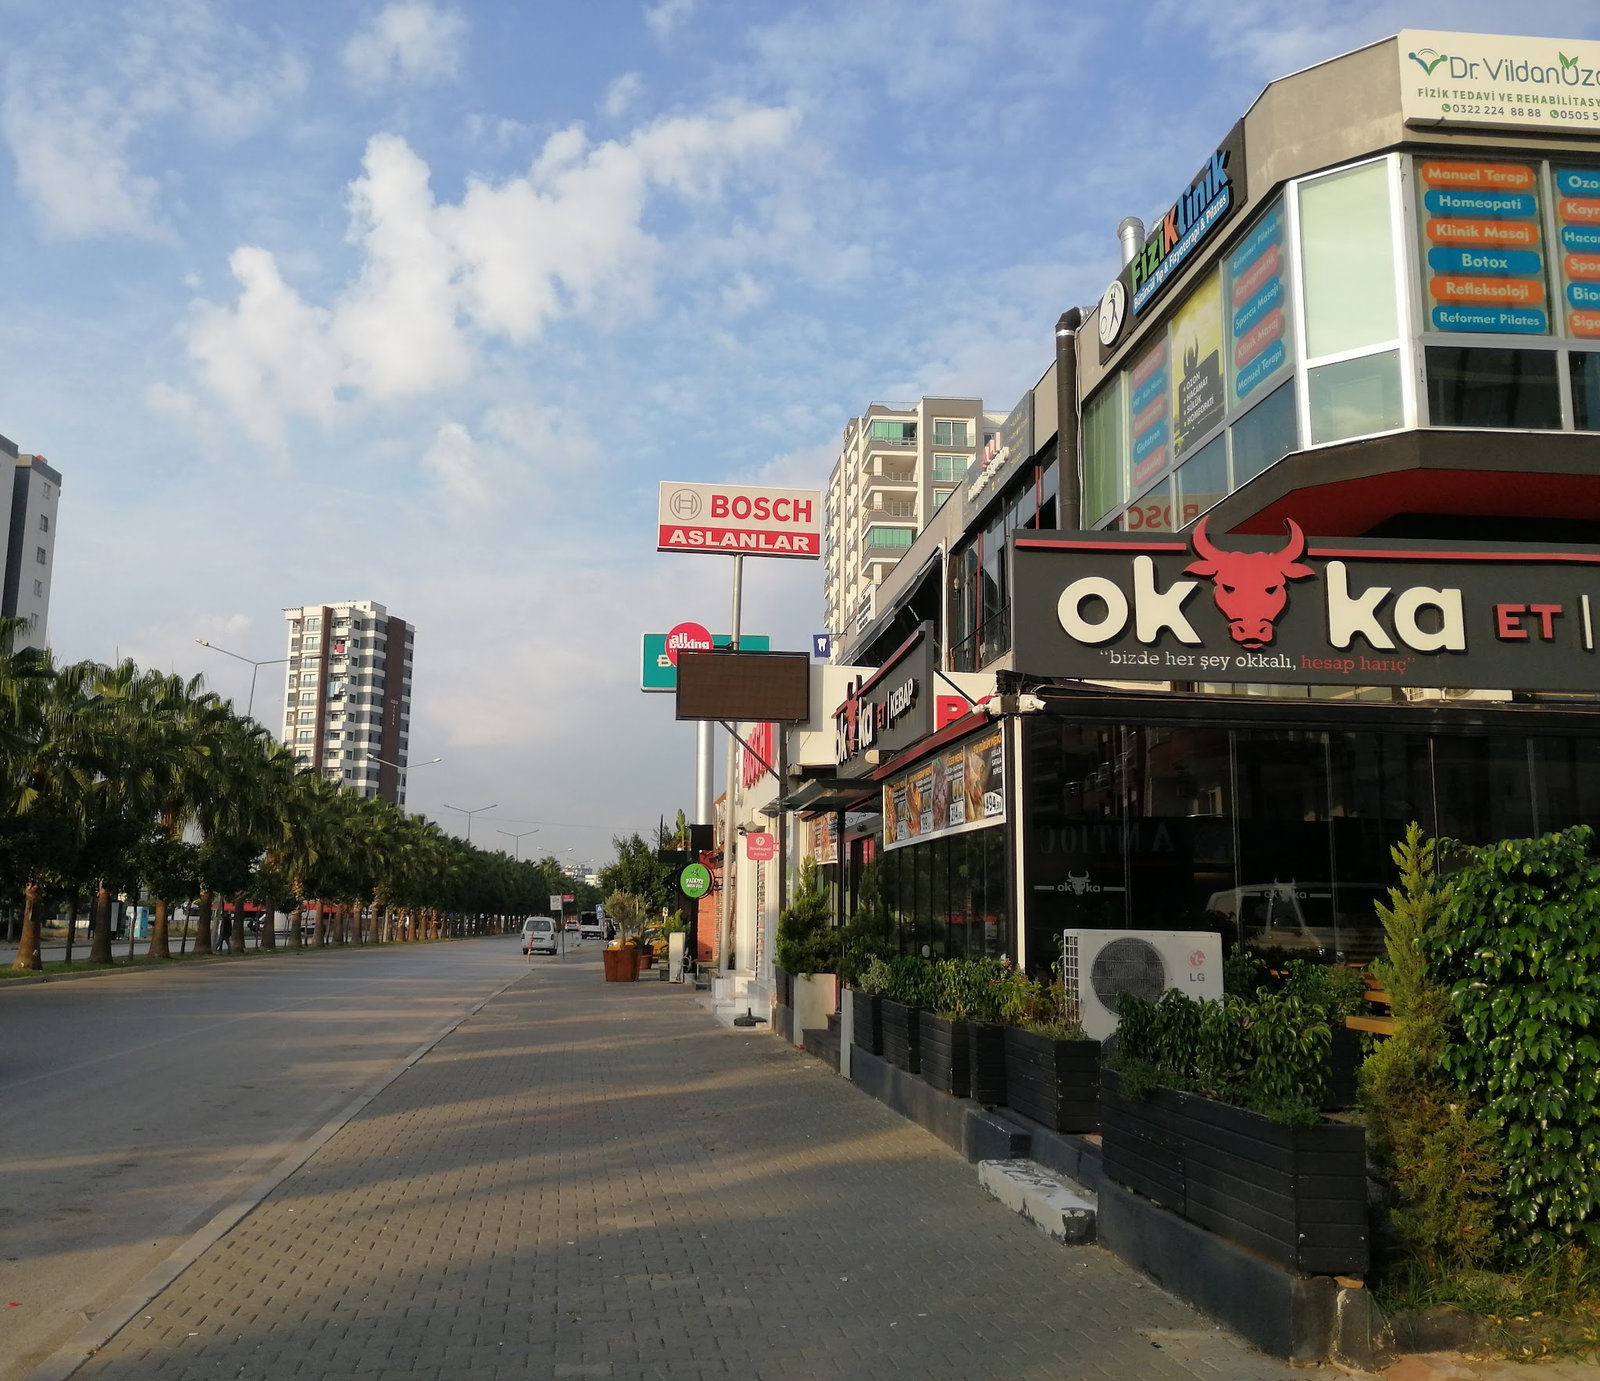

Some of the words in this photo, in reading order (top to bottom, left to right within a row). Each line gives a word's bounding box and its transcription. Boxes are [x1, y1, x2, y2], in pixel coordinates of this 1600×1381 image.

[1449, 56, 1479, 80] Dr.
[1483, 57, 1560, 84] Vildan
[1418, 87, 1449, 99] FİZİK
[1453, 89, 1495, 101] TEDAVİ
[1499, 93, 1513, 103] VE
[1453, 104, 1481, 114] 0322
[1484, 105, 1505, 115] 224
[1510, 107, 1526, 117] 88
[1528, 108, 1541, 118] 88
[1560, 110, 1590, 120] 0505
[1428, 168, 1481, 181] Manuel
[1484, 169, 1529, 185] Terapi
[1439, 194, 1522, 211] Homeopati
[1436, 223, 1479, 238] Klinik
[1484, 226, 1530, 242] Masaj
[1462, 253, 1509, 269] Botox
[1446, 281, 1529, 299] Refleksoloji
[1440, 311, 1496, 324] Reformer
[1500, 313, 1540, 326] Pilates
[1237, 363, 1261, 392] Manuel
[1261, 346, 1282, 372] Terapi
[711, 494, 812, 523] BOSCH
[668, 529, 810, 551] ASLANLAR
[1496, 603, 1562, 639] ET
[1165, 651, 1196, 667] her
[1200, 655, 1231, 671] şey
[1300, 655, 1355, 674] hesap
[890, 678, 914, 720] KEBAP
[1189, 972, 1206, 982] LG
